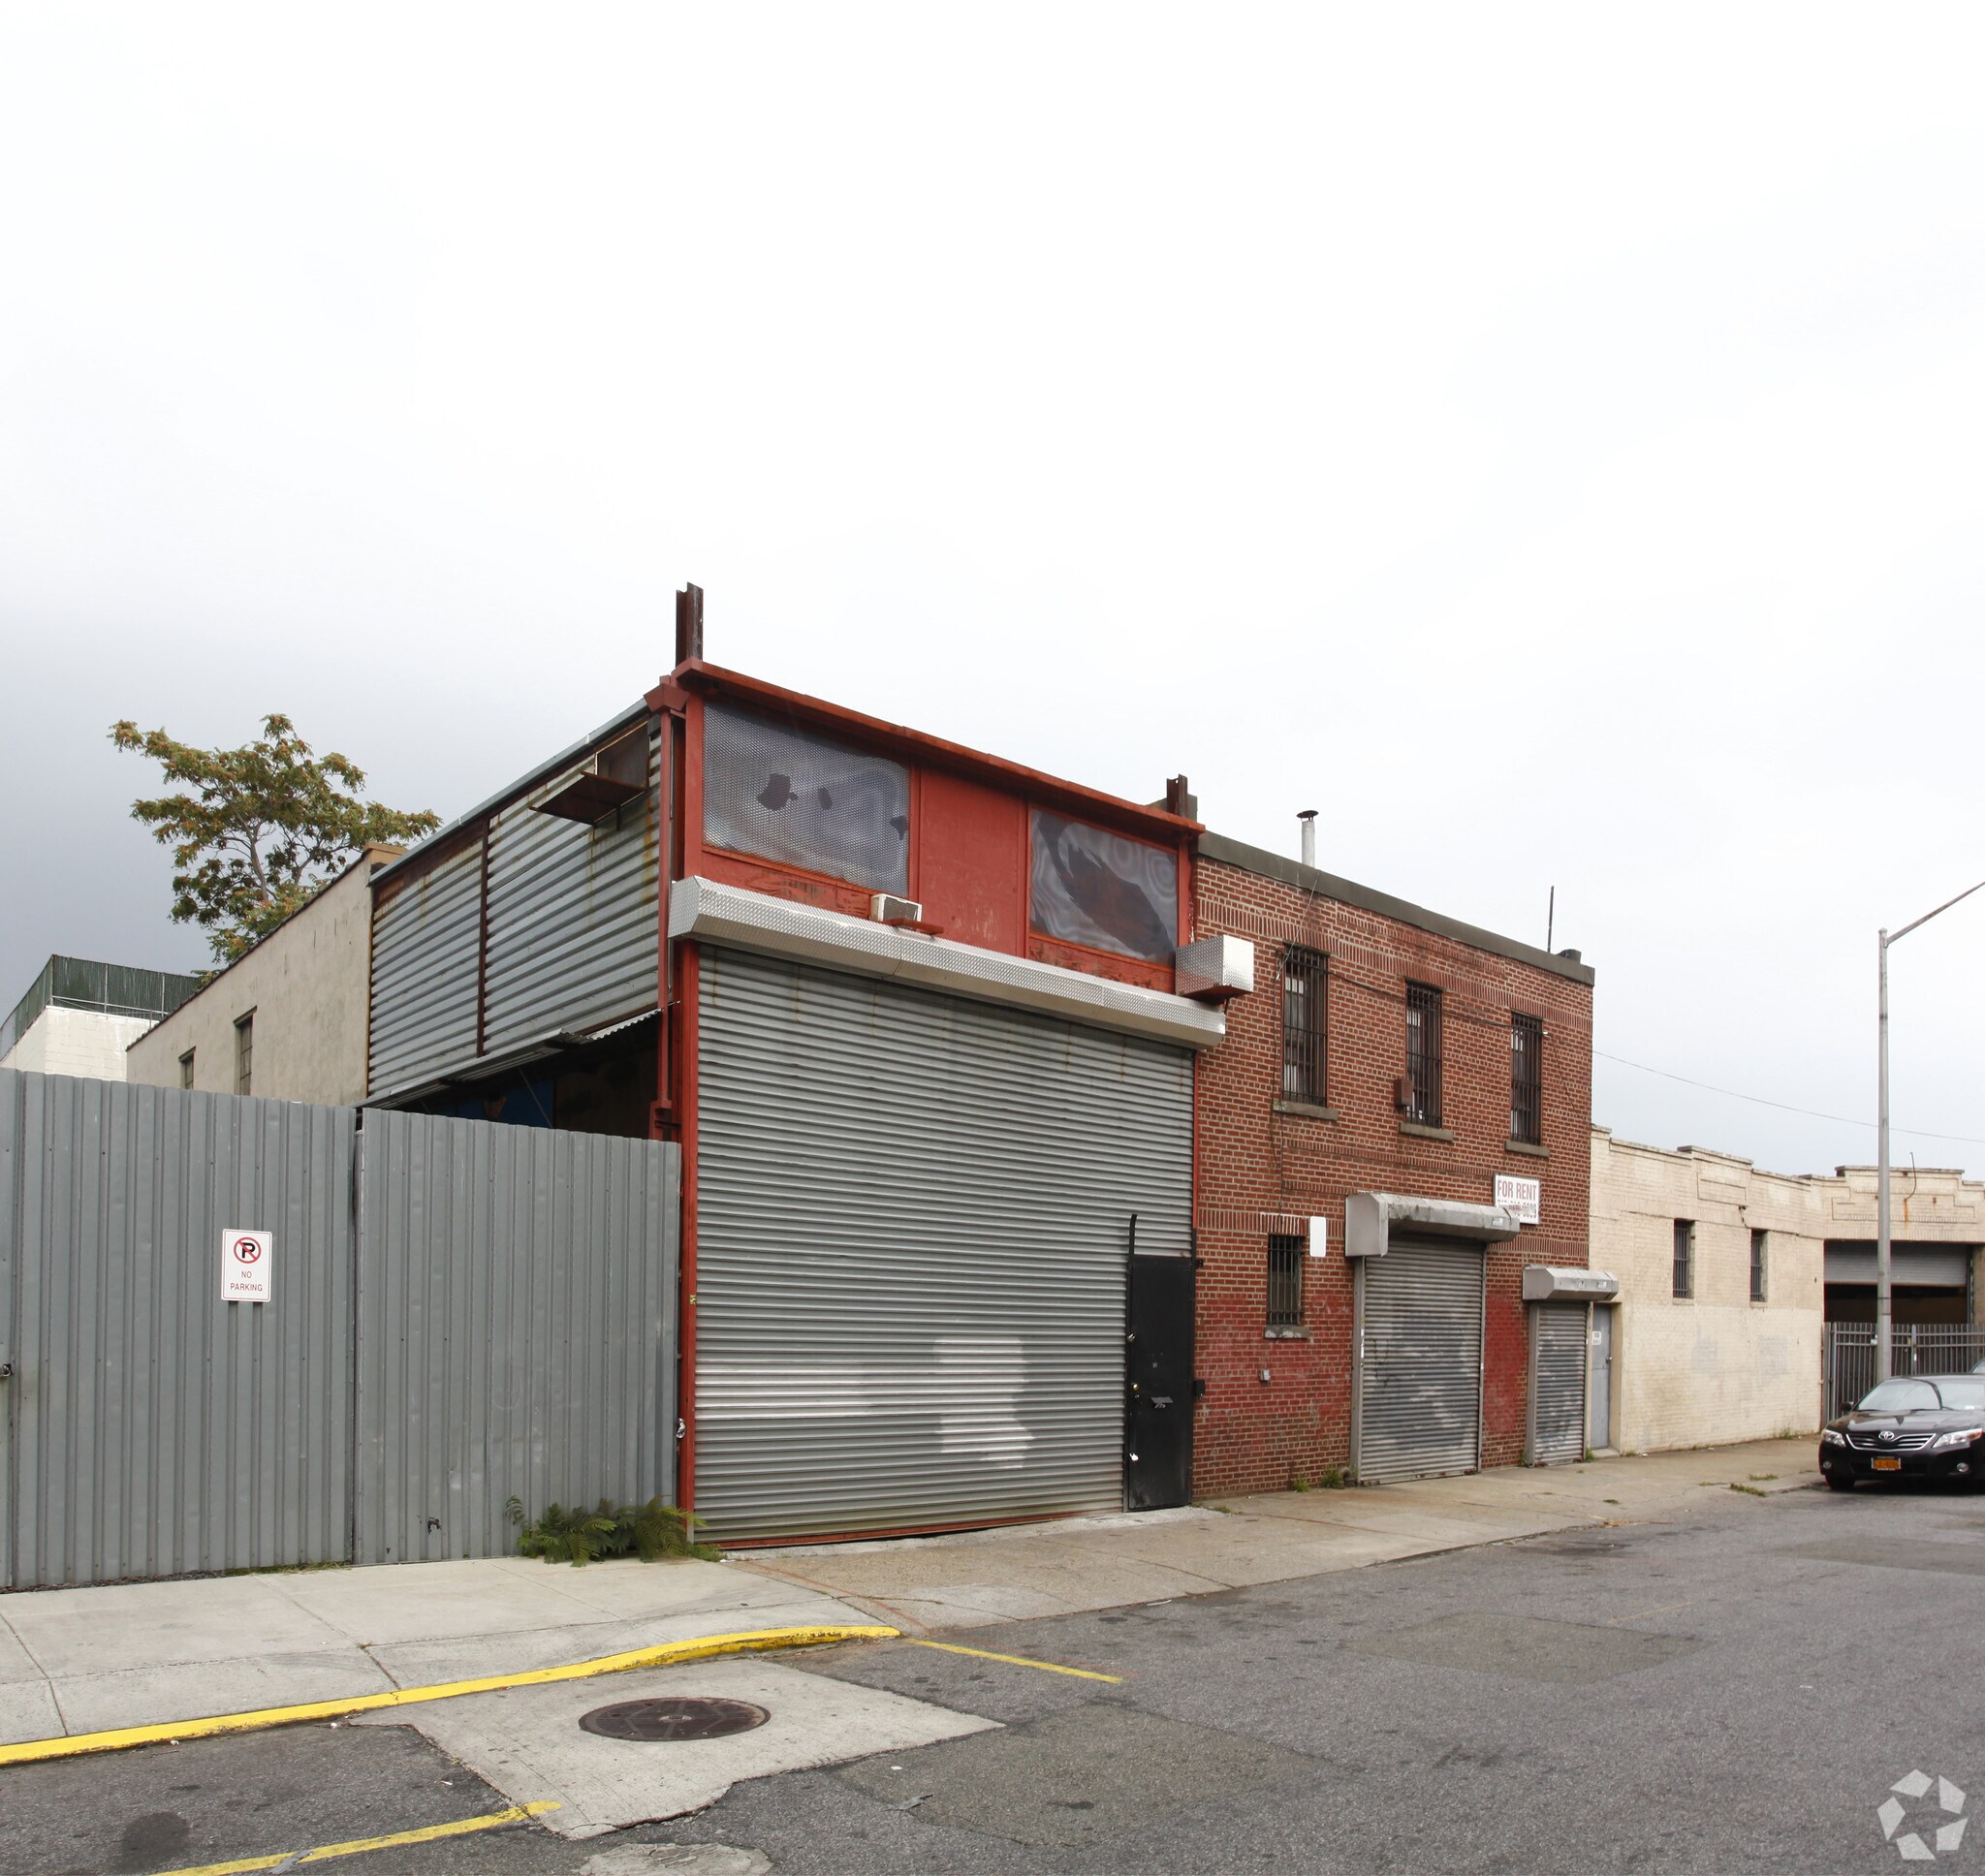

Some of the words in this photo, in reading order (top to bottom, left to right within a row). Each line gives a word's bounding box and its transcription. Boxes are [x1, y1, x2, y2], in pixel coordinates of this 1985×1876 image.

[1497, 1179, 1513, 1198] FOR
[1516, 1182, 1537, 1201] RENT
[230, 1282, 263, 1292] PARKING
